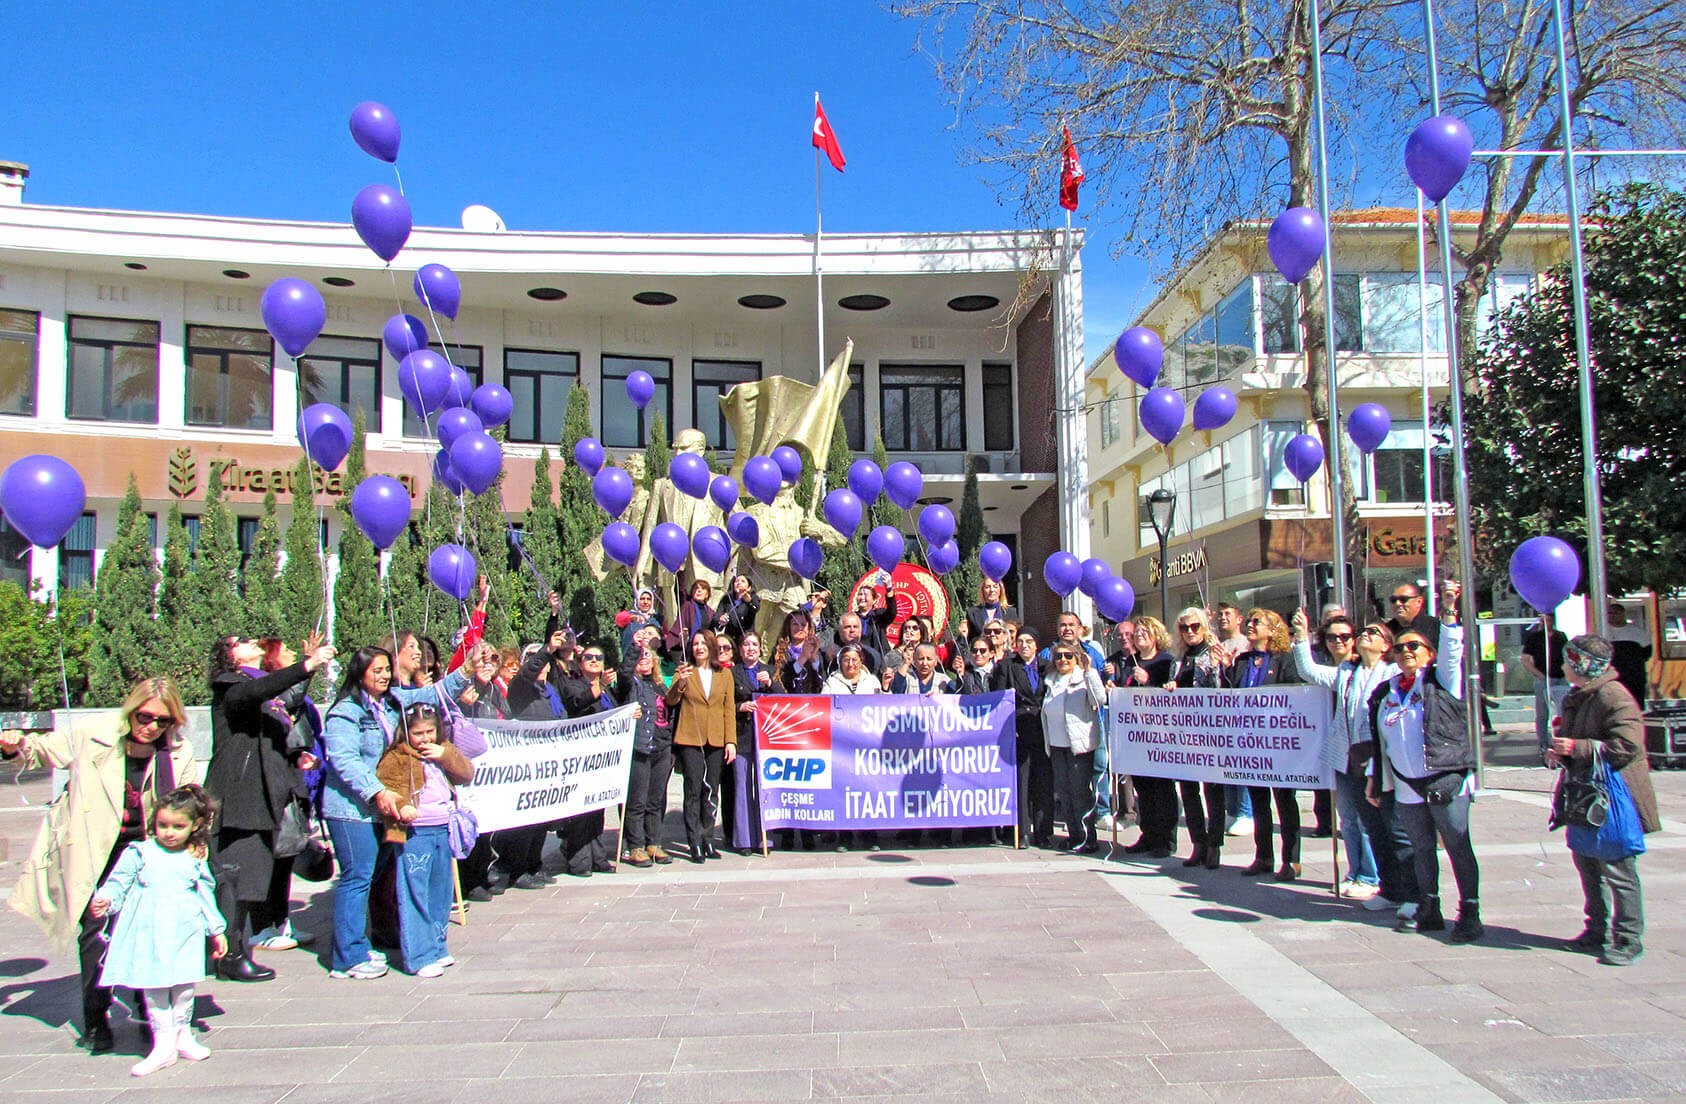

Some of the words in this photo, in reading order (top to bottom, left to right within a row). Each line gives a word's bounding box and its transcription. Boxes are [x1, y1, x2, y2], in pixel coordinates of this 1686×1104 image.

[1133, 694, 1143, 707] EY
[1144, 695, 1204, 708] KAHRAMAN
[1207, 692, 1240, 708] TÜRK
[861, 703, 993, 734] SUSMUYORUZ
[1117, 711, 1138, 724] SEN
[1139, 712, 1170, 726] YERDE
[1171, 711, 1266, 729] SÜRÜKLENMEYE
[1269, 712, 1316, 731] DEĞİL,
[560, 720, 608, 742] KADINLAR
[1127, 730, 1177, 745] OMUZLAR
[1178, 731, 1234, 748] ÜZERİNDE
[1236, 732, 1302, 750] GÖKLERE
[463, 762, 532, 788] ÜNYADA
[535, 760, 558, 780] HER
[561, 756, 582, 781] ŞEY
[582, 749, 622, 773] KADININ
[763, 757, 826, 782] CHP
[855, 745, 1001, 776] KORKMUYORUZ
[1146, 747, 1215, 767] YÜKSELMEYE
[1217, 754, 1273, 770] LAYIKSIN
[1223, 771, 1256, 780] MUSTAFA
[1256, 773, 1284, 782] KEMAL
[1284, 773, 1321, 784] ATATÜRK
[780, 791, 815, 807] ÇEŞME
[845, 786, 898, 819] İTAAT
[903, 784, 1012, 818] ETMİYORUZ
[793, 808, 835, 822] KOLLARI
